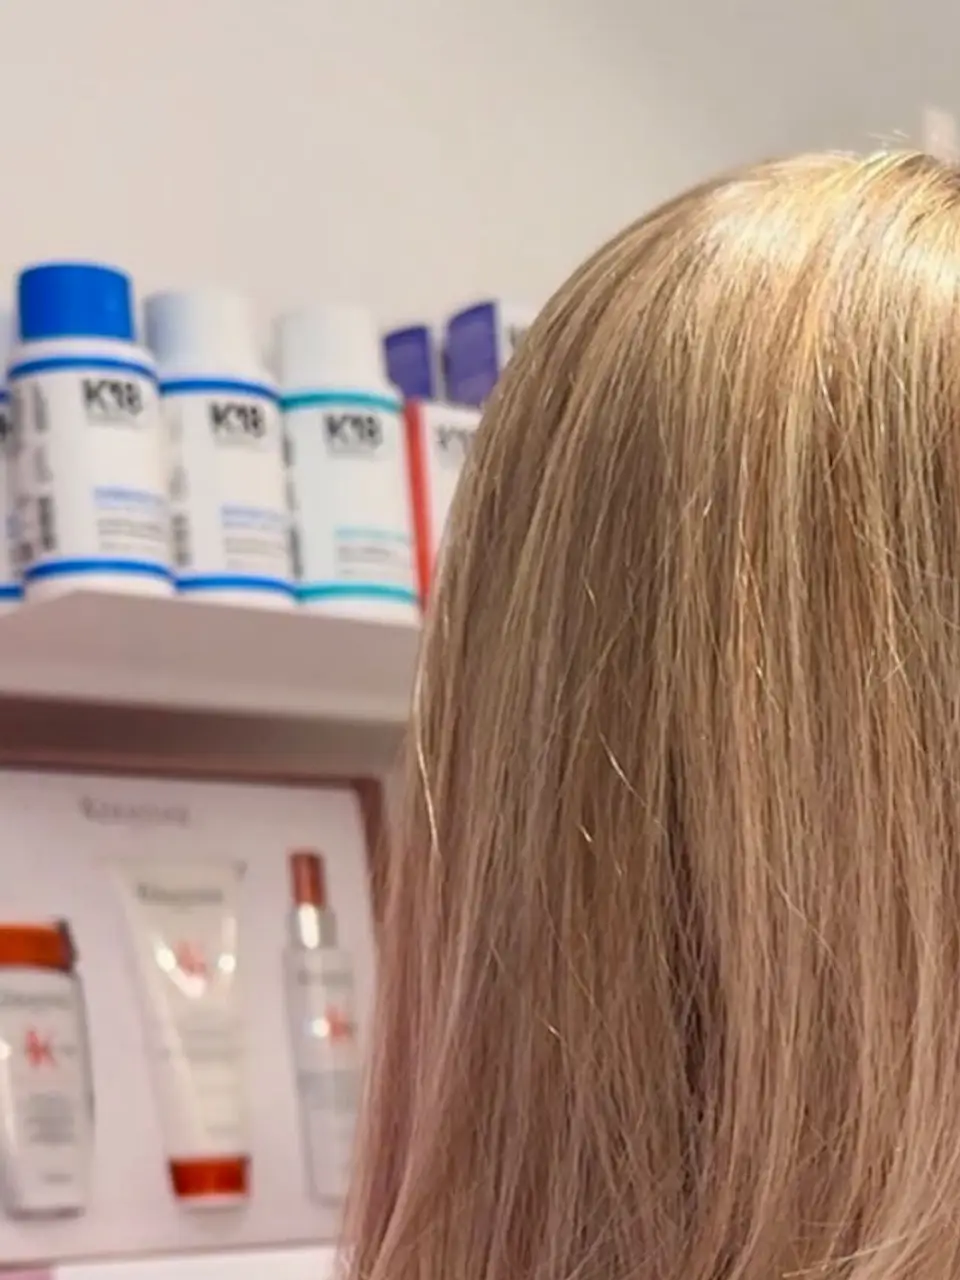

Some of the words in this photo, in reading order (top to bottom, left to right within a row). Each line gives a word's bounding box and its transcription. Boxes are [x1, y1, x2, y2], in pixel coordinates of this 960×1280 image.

[82, 378, 144, 416] K18
[209, 400, 267, 439] K18
[323, 413, 384, 450] K18
